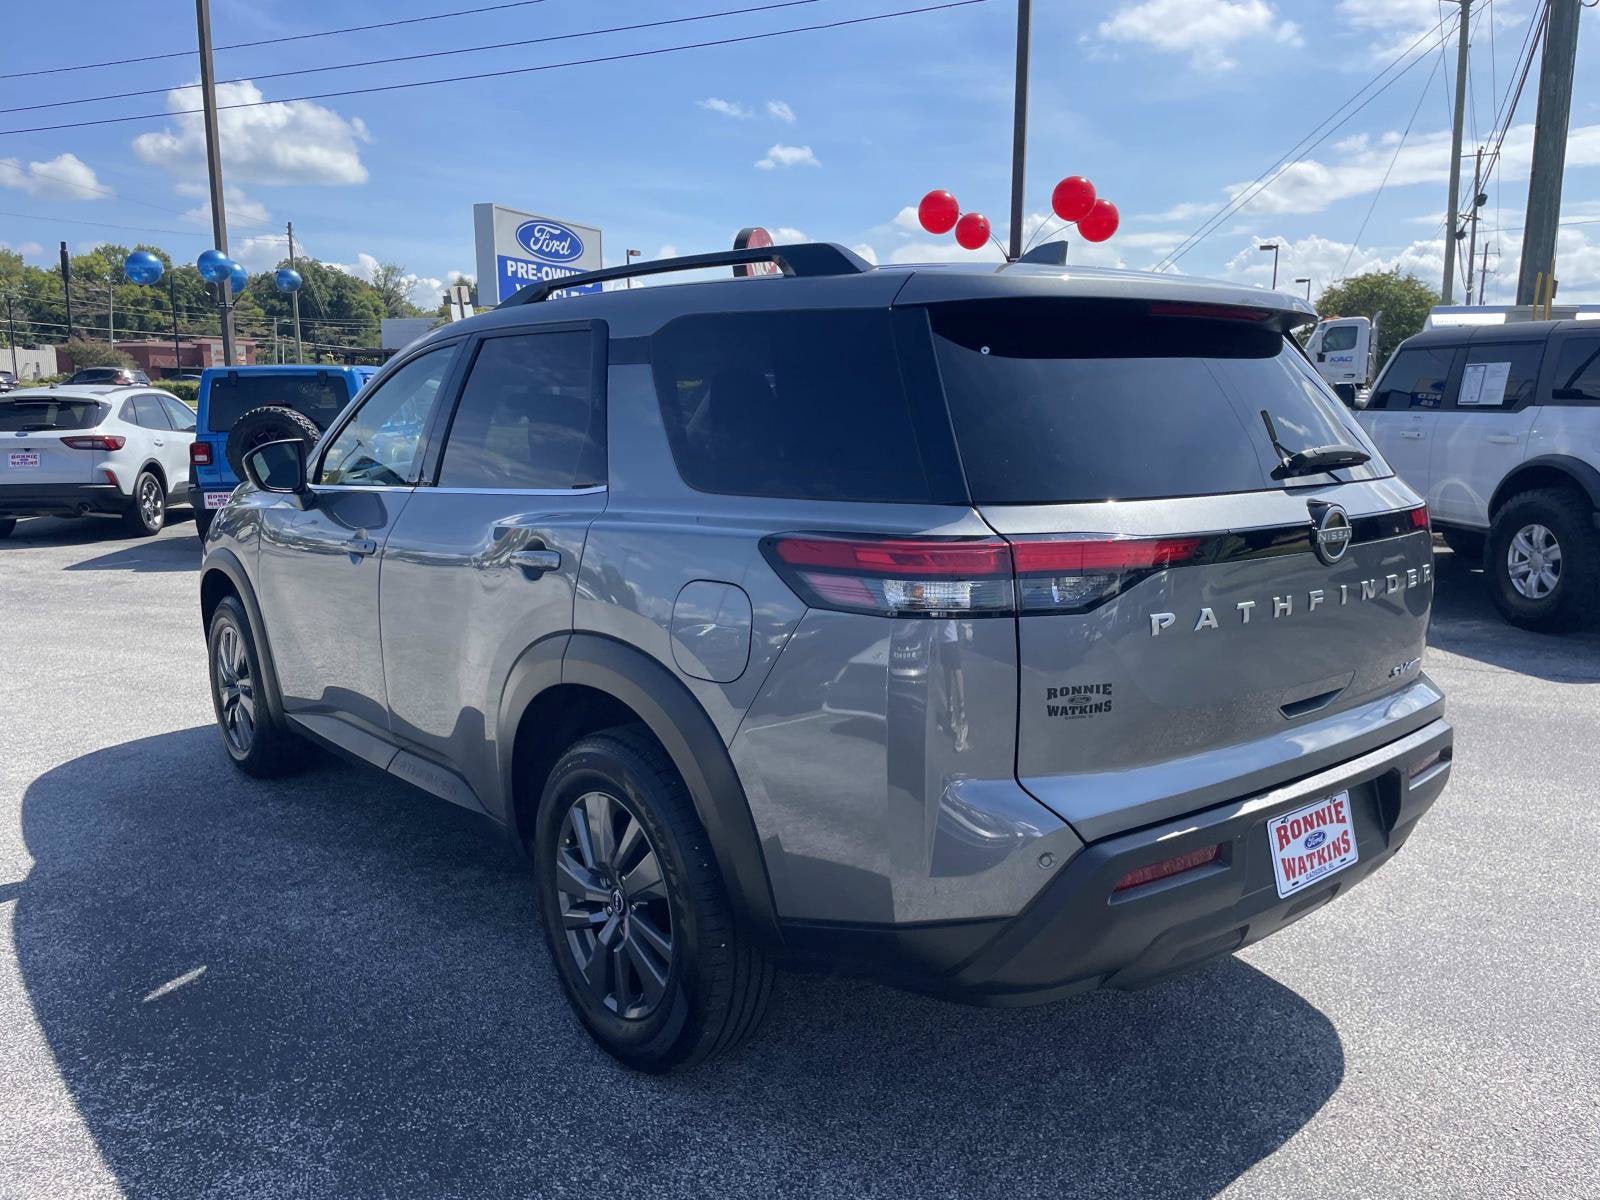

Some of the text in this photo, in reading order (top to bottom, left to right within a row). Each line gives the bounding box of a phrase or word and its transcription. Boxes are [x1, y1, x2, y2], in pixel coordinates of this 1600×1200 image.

[530, 225, 571, 255] Ford
[506, 260, 589, 284] PRE-OWN
[1318, 529, 1352, 541] NISSAN
[1150, 564, 1431, 636] PATHFINDER
[1047, 683, 1112, 700] RONNIE
[1047, 700, 1112, 717] WATKINS
[1276, 801, 1347, 852] RONNIE
[1281, 829, 1351, 881] WATKINS
